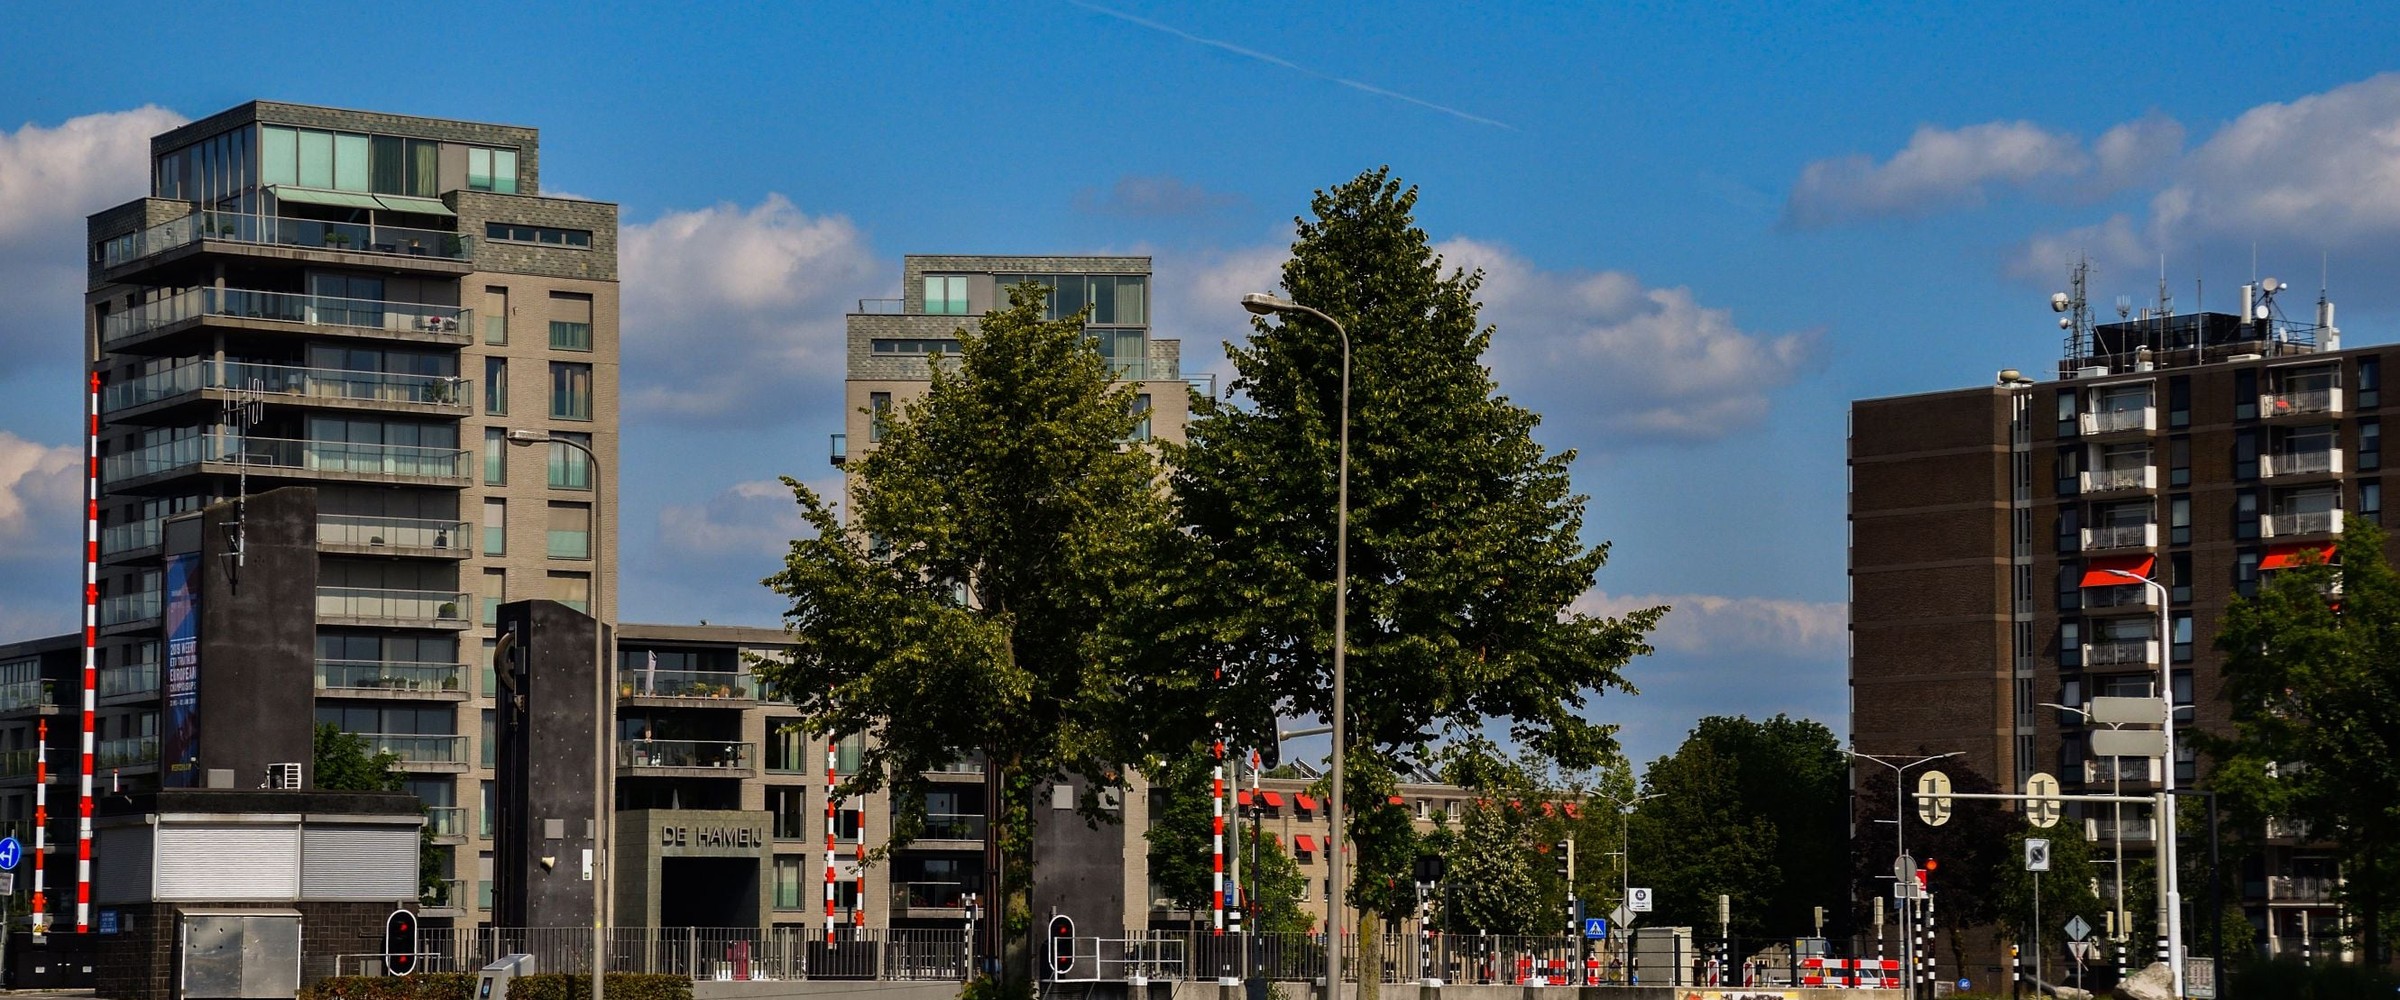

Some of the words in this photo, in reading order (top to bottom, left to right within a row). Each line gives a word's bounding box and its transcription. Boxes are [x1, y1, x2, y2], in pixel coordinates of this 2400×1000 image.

[170, 643, 180, 655] 2019
[181, 641, 197, 653] WEERT
[170, 667, 196, 681] EUROPEAN
[662, 826, 686, 845] DE
[696, 826, 764, 847] HAMEIJ
